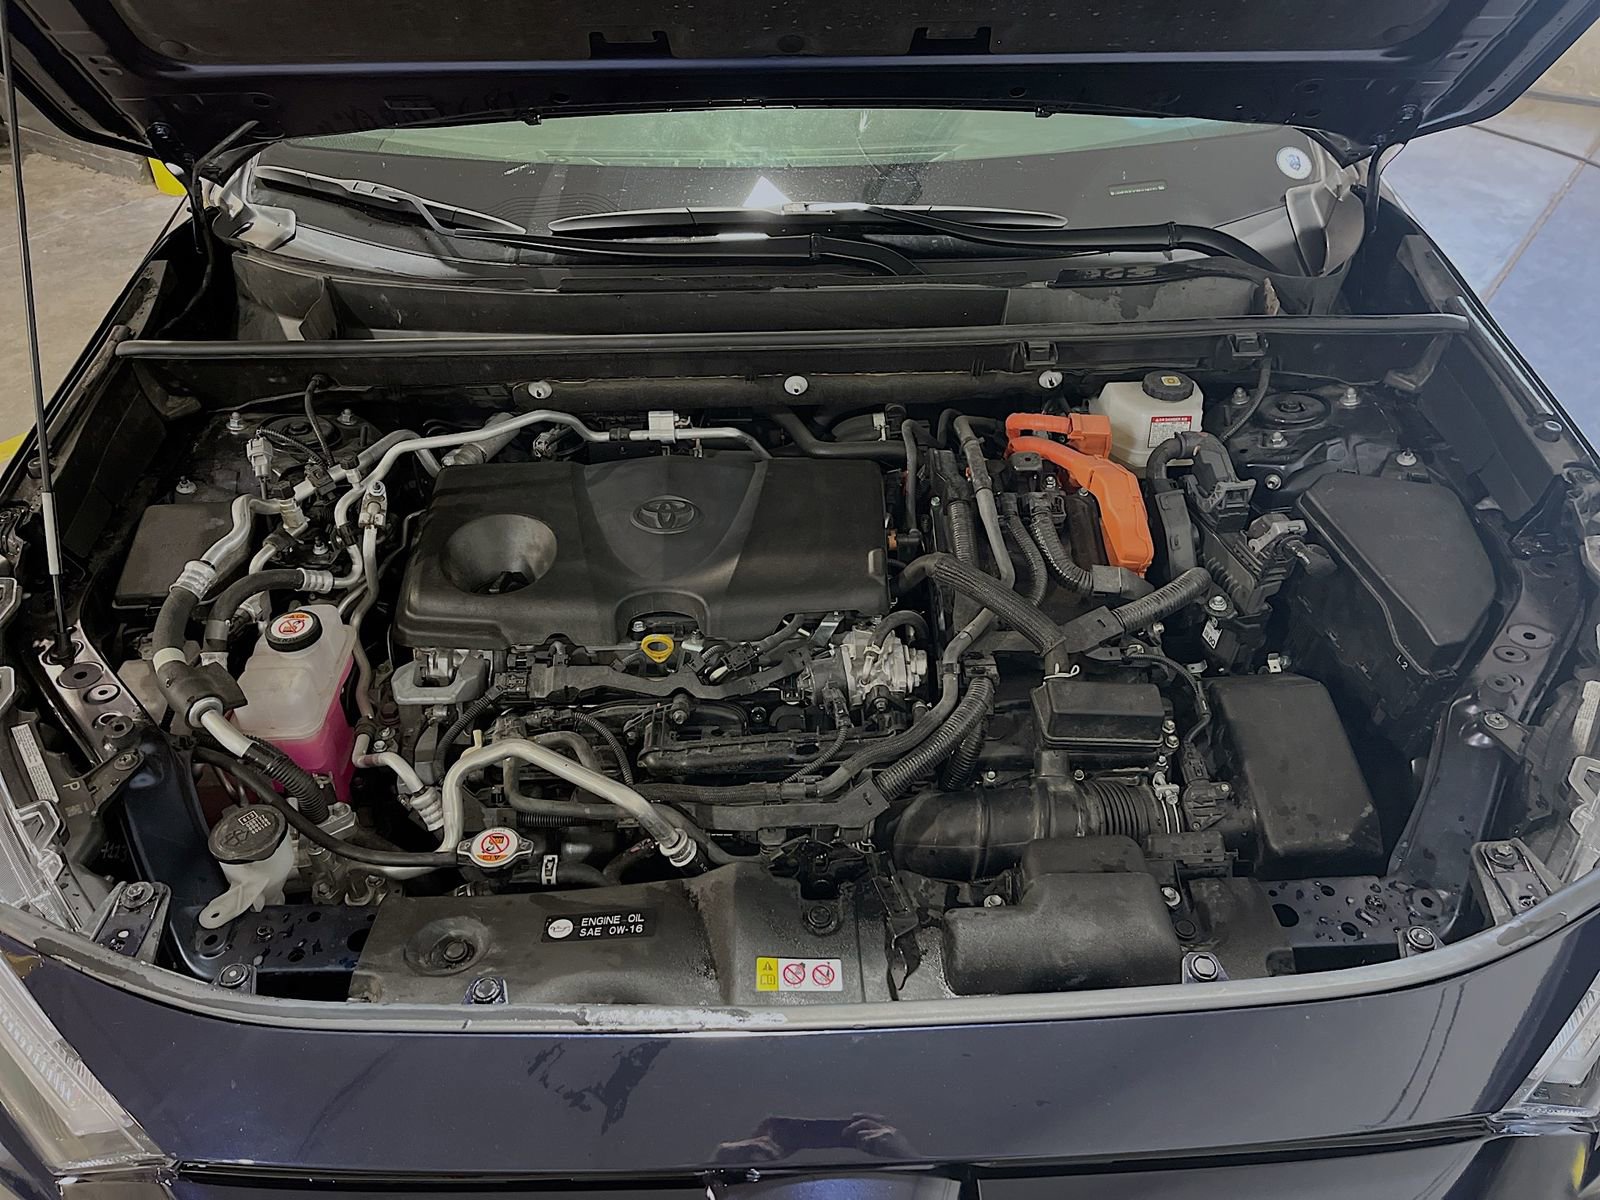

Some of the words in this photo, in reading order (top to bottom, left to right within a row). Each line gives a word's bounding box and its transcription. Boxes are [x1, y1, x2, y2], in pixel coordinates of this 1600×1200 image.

[581, 915, 621, 927] ENGINE
[628, 913, 645, 923] OIL
[579, 927, 602, 937] SAE
[608, 924, 643, 935] 0W-16
